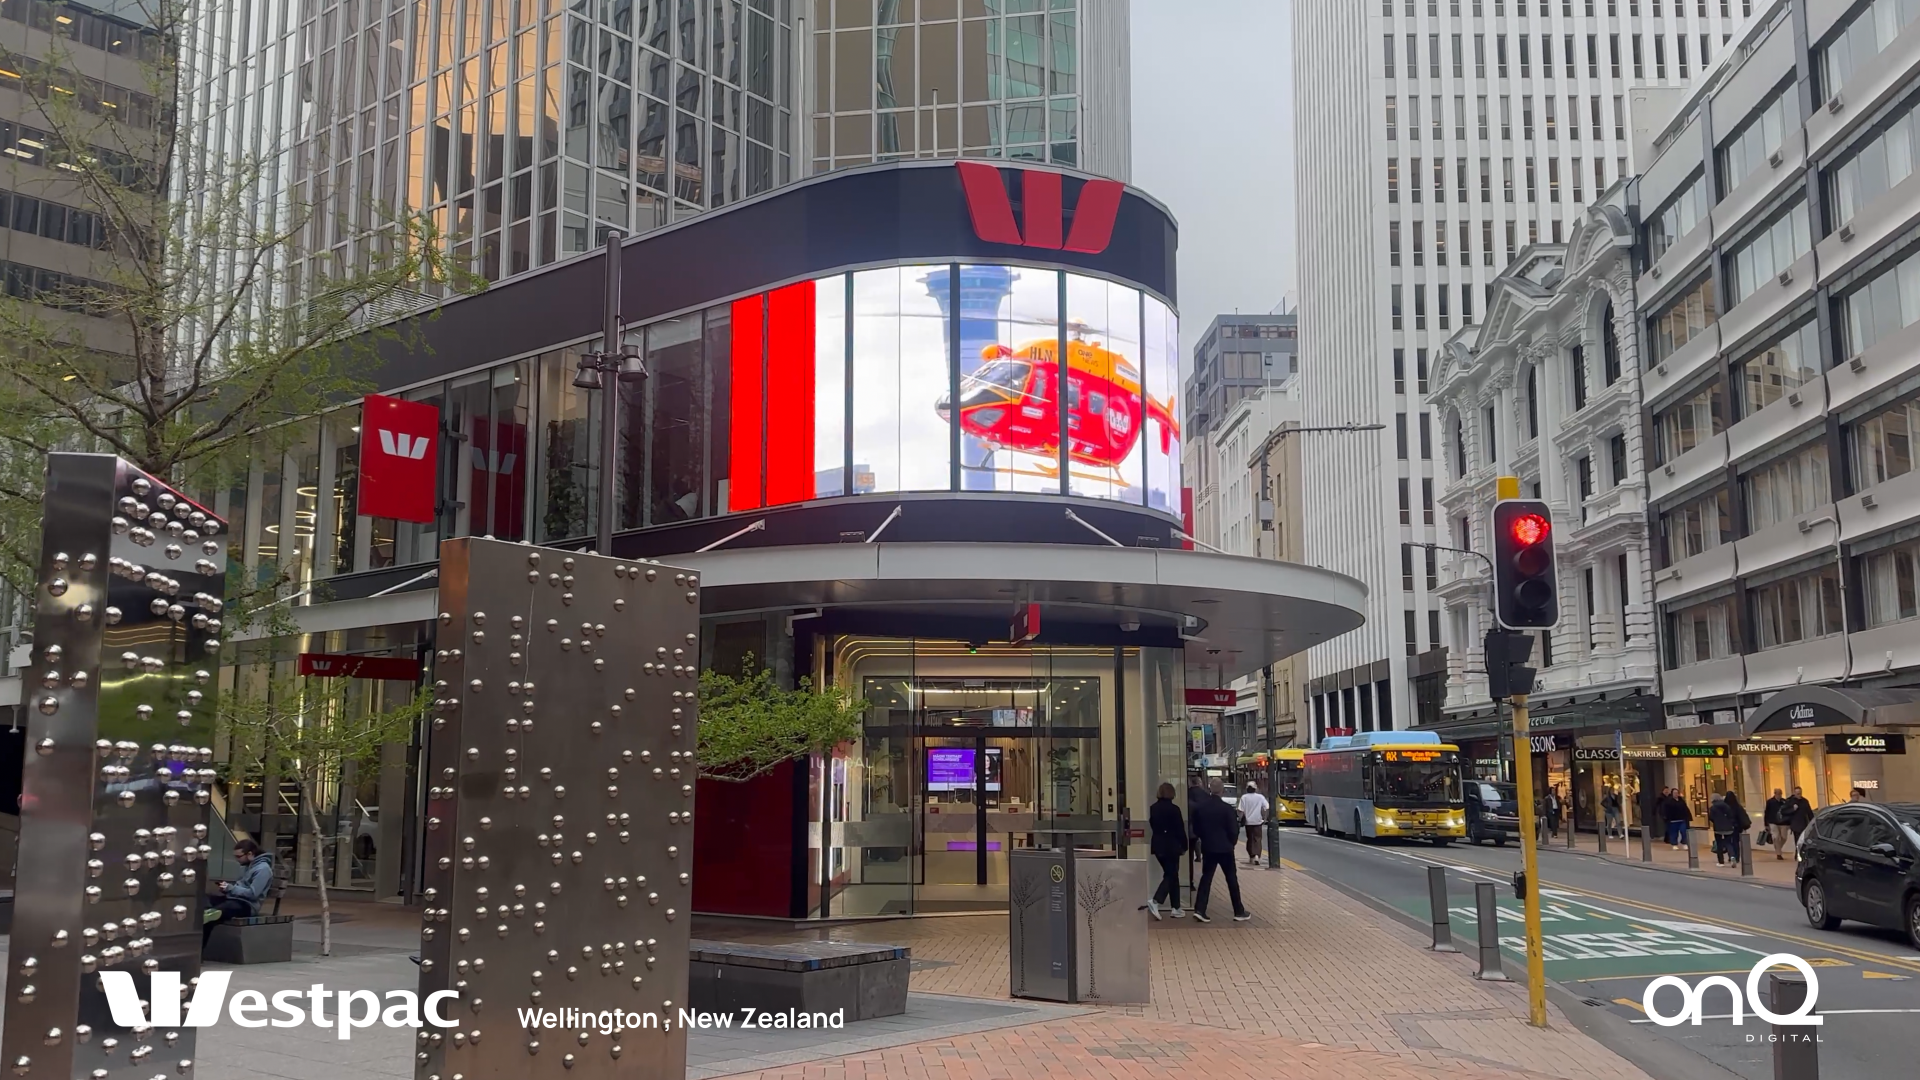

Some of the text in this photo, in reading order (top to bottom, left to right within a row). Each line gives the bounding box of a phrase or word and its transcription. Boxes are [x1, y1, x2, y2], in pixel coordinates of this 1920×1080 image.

[1790, 704, 1814, 720] Adina
[1846, 736, 1886, 746] Adina
[1681, 748, 1715, 756] ROLEX
[1736, 744, 1795, 752] PATEK PHILIPPE
